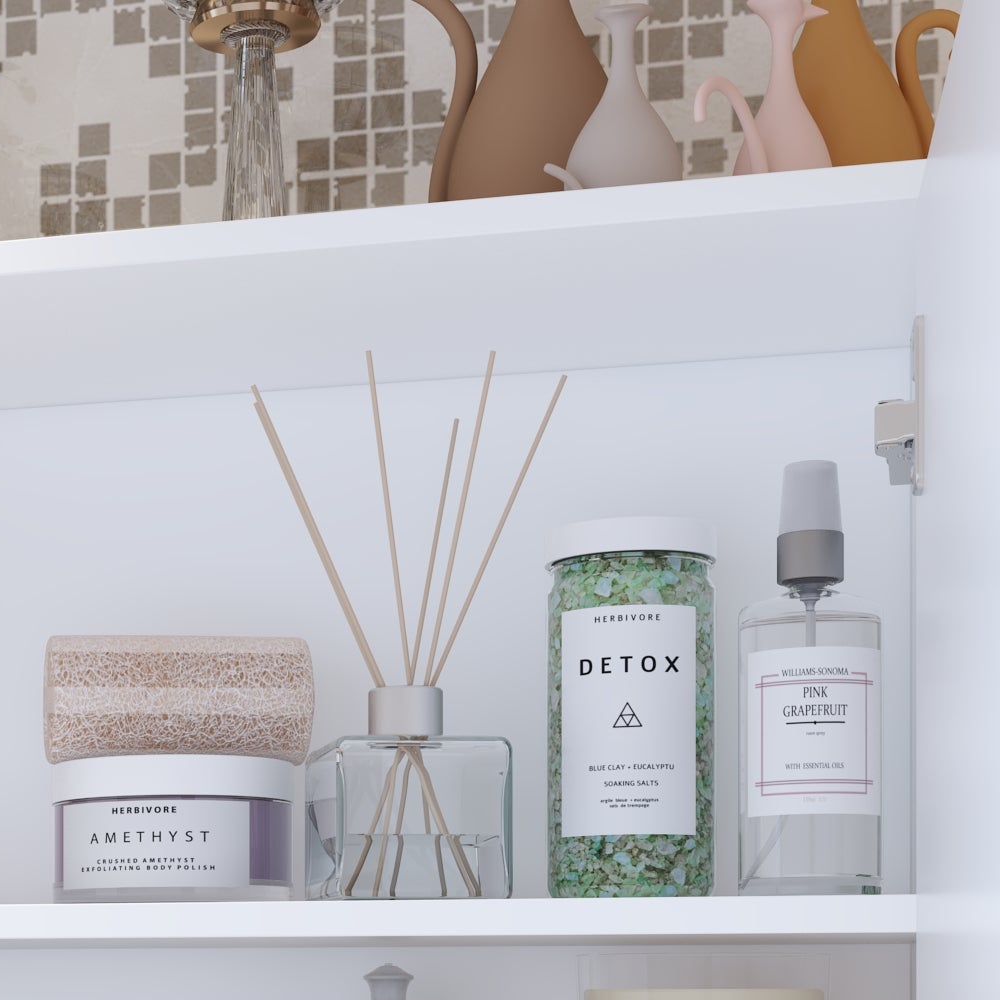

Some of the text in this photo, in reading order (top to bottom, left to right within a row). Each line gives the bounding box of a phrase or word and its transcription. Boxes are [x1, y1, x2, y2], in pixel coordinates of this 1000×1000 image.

[594, 613, 661, 624] HERBIVORE
[579, 655, 680, 676] DETOX
[781, 667, 849, 677] WILLIAMS-SONOMA
[803, 686, 829, 698] PINK
[783, 704, 849, 718] GRAPEFRUIT
[785, 762, 801, 770] WITH
[802, 762, 831, 770] ESSENTIAL
[604, 780, 635, 788] SOAKING
[111, 806, 178, 815] HERBIVORE
[90, 830, 210, 845] AMETHYST
[81, 865, 141, 873] EXFOLIATING
